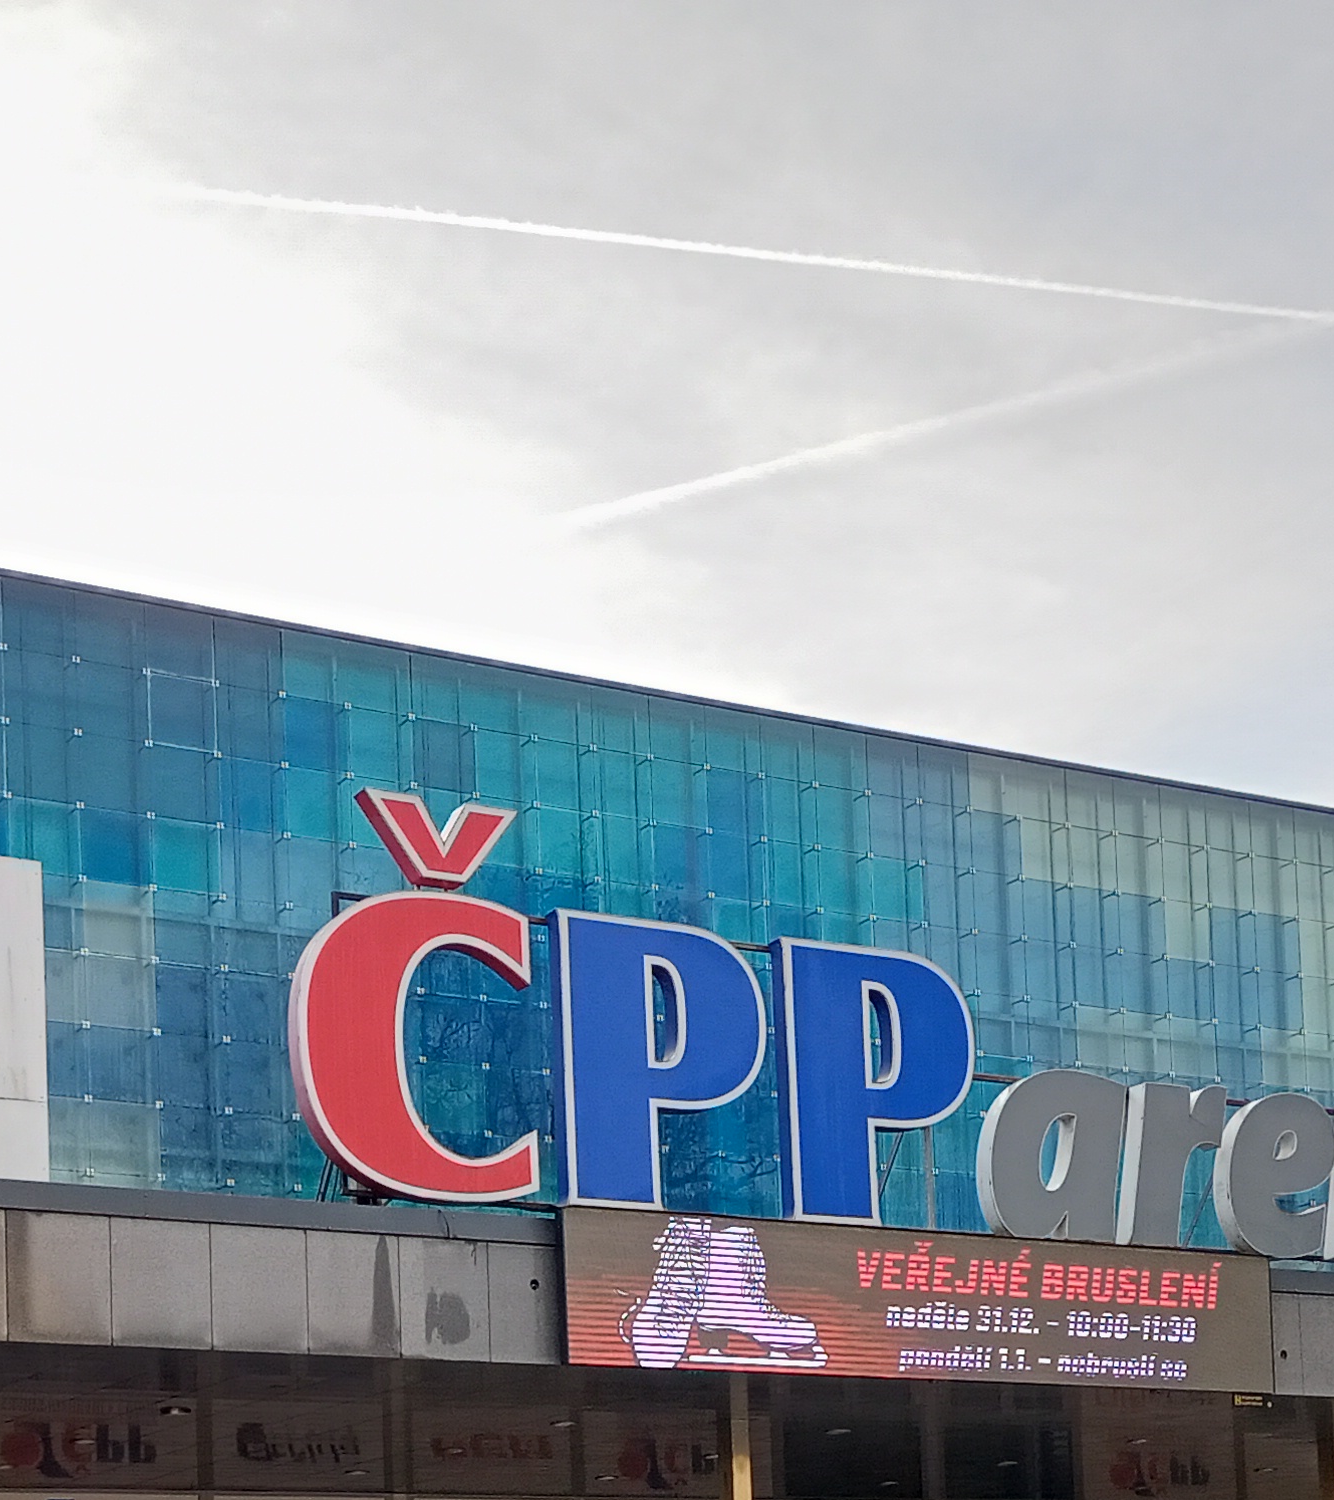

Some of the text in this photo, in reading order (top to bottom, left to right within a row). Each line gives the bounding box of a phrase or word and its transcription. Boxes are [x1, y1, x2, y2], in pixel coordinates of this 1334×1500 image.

[289, 787, 974, 1226] ČPP
[856, 1240, 1223, 1310] VEŘEJNÉ BRUSLENÍ
[975, 1305, 1041, 1335] 31.12.
